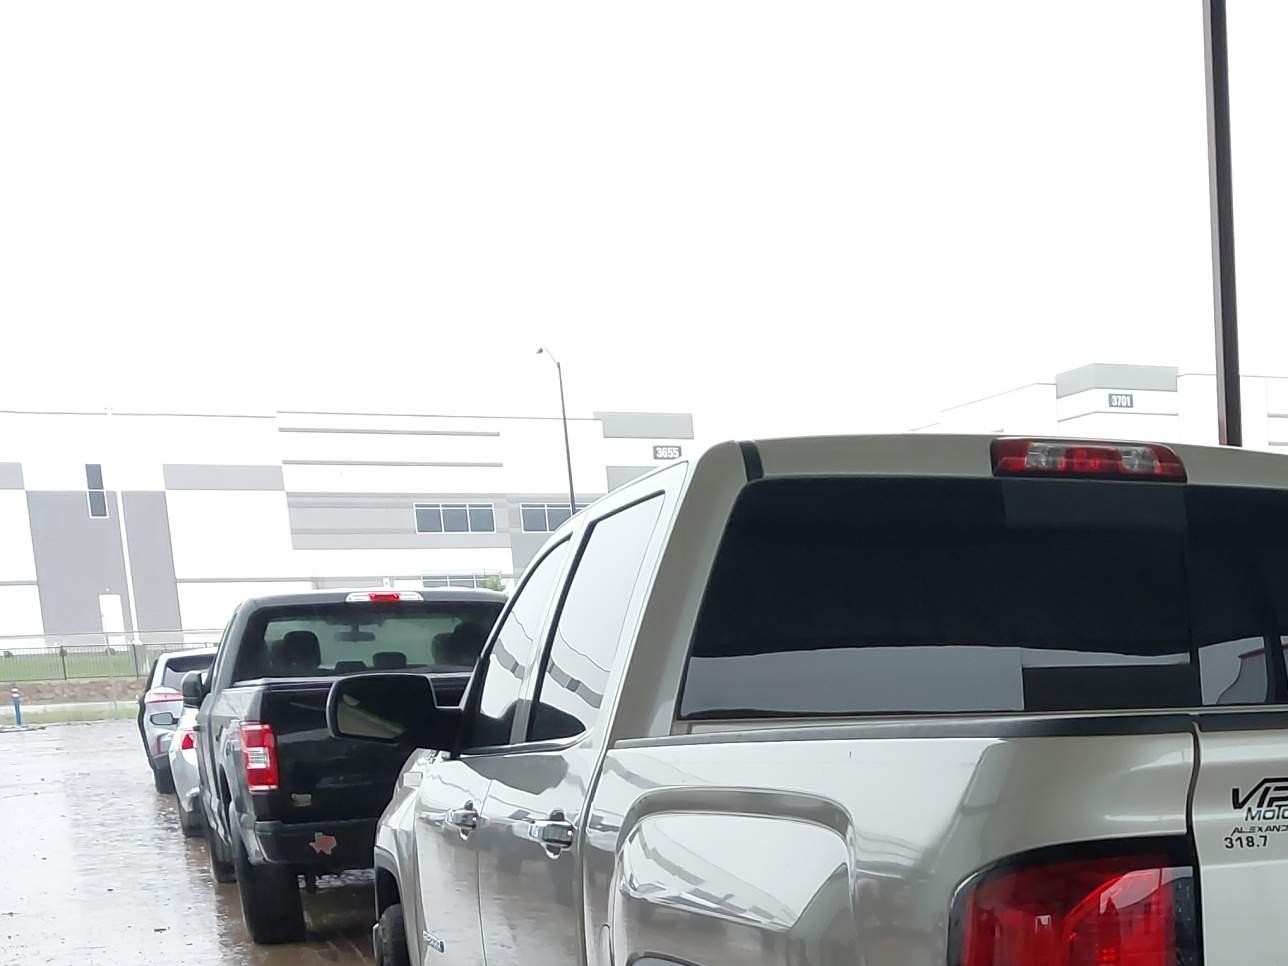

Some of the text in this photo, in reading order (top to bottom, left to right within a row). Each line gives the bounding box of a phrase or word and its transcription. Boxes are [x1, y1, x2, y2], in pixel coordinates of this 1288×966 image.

[1111, 394, 1131, 407] 3701
[655, 446, 680, 458] 3655
[1223, 835, 1268, 849] 318.7
